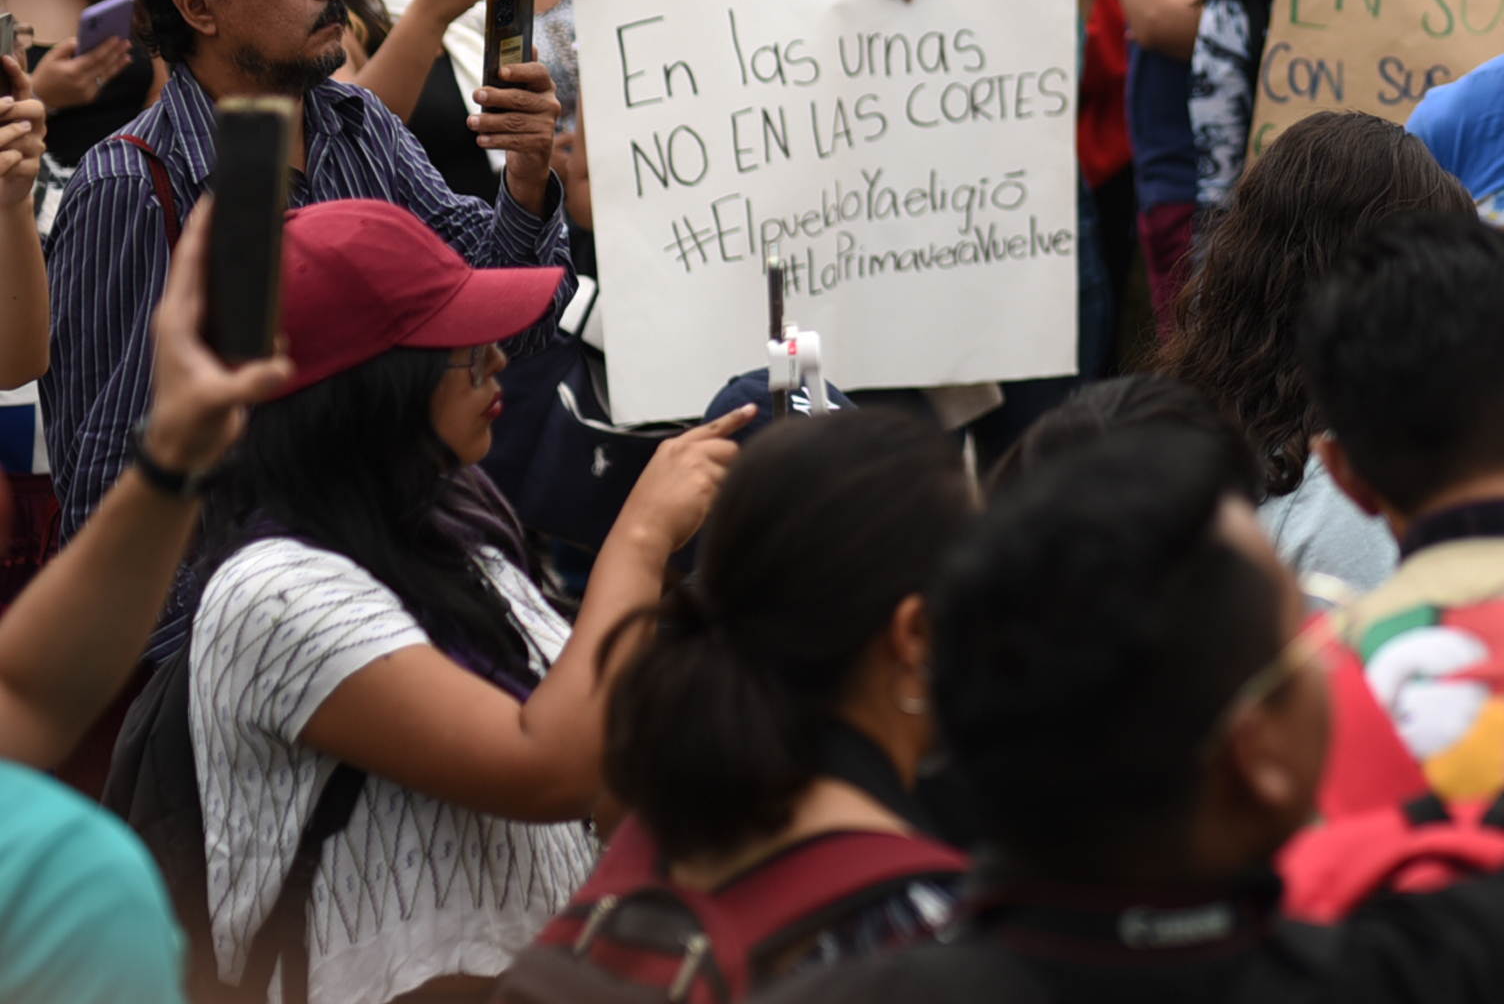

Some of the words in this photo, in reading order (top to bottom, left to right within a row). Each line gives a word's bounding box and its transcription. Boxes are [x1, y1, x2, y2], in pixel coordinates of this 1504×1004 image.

[616, 15, 698, 109] En
[728, 8, 820, 86] las
[838, 28, 987, 79] urnas
[1262, 41, 1345, 105] CON
[630, 124, 708, 198] NO
[731, 106, 792, 174] EN
[811, 93, 888, 160] LAS
[906, 66, 1070, 129] CORTES
